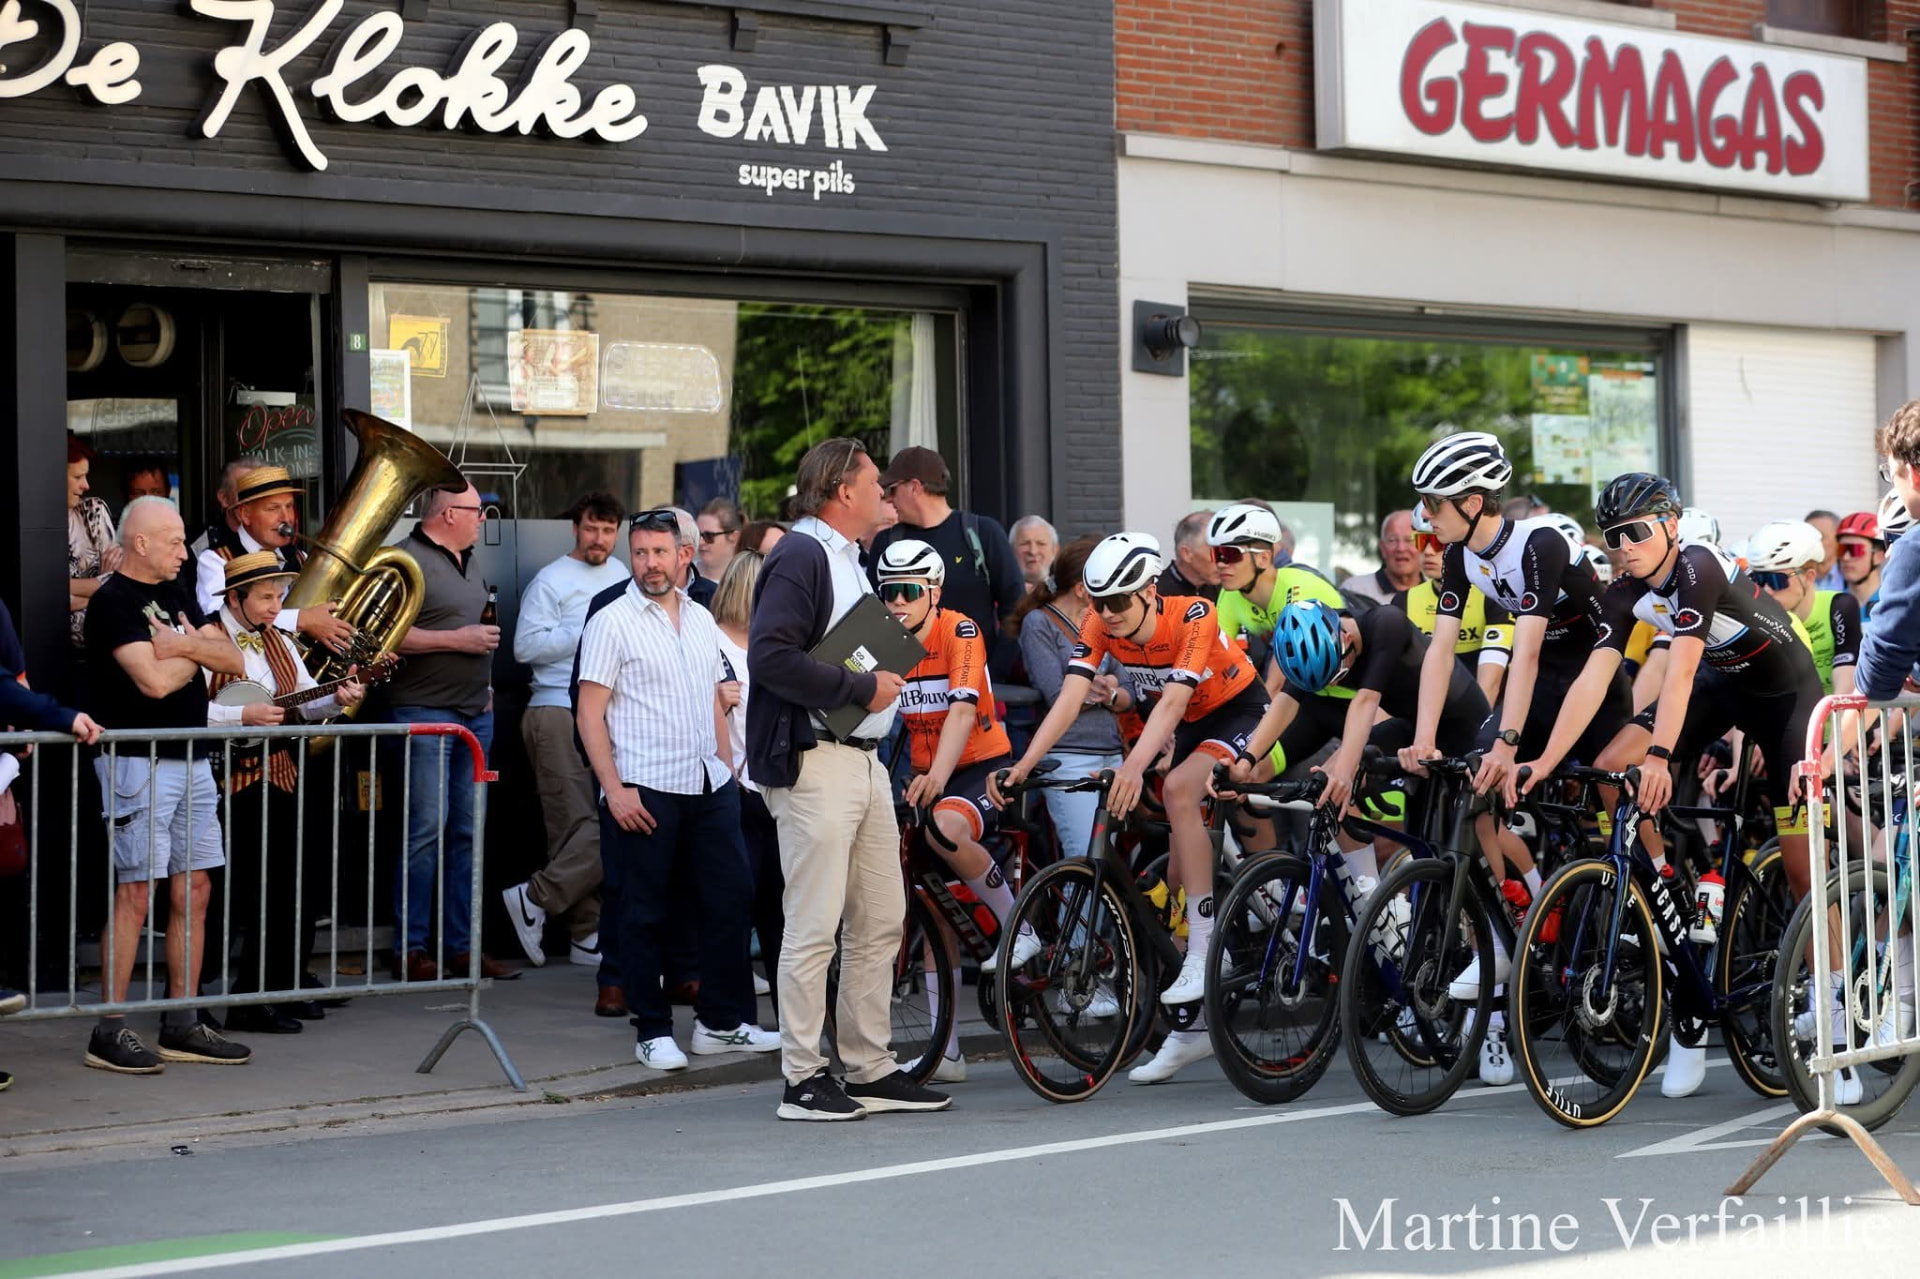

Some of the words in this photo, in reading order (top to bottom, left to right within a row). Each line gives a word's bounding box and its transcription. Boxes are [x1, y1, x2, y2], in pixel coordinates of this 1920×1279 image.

[190, 0, 648, 171] Klokke
[697, 64, 888, 152] BAVIK
[1400, 17, 1825, 176] GERMAGAS
[738, 161, 809, 196] super
[812, 160, 856, 199] pils
[353, 333, 362, 350] 8
[239, 405, 316, 451] Open
[1788, 984, 1799, 1061] RESERVE
[1546, 1084, 1582, 1119] UTILE
